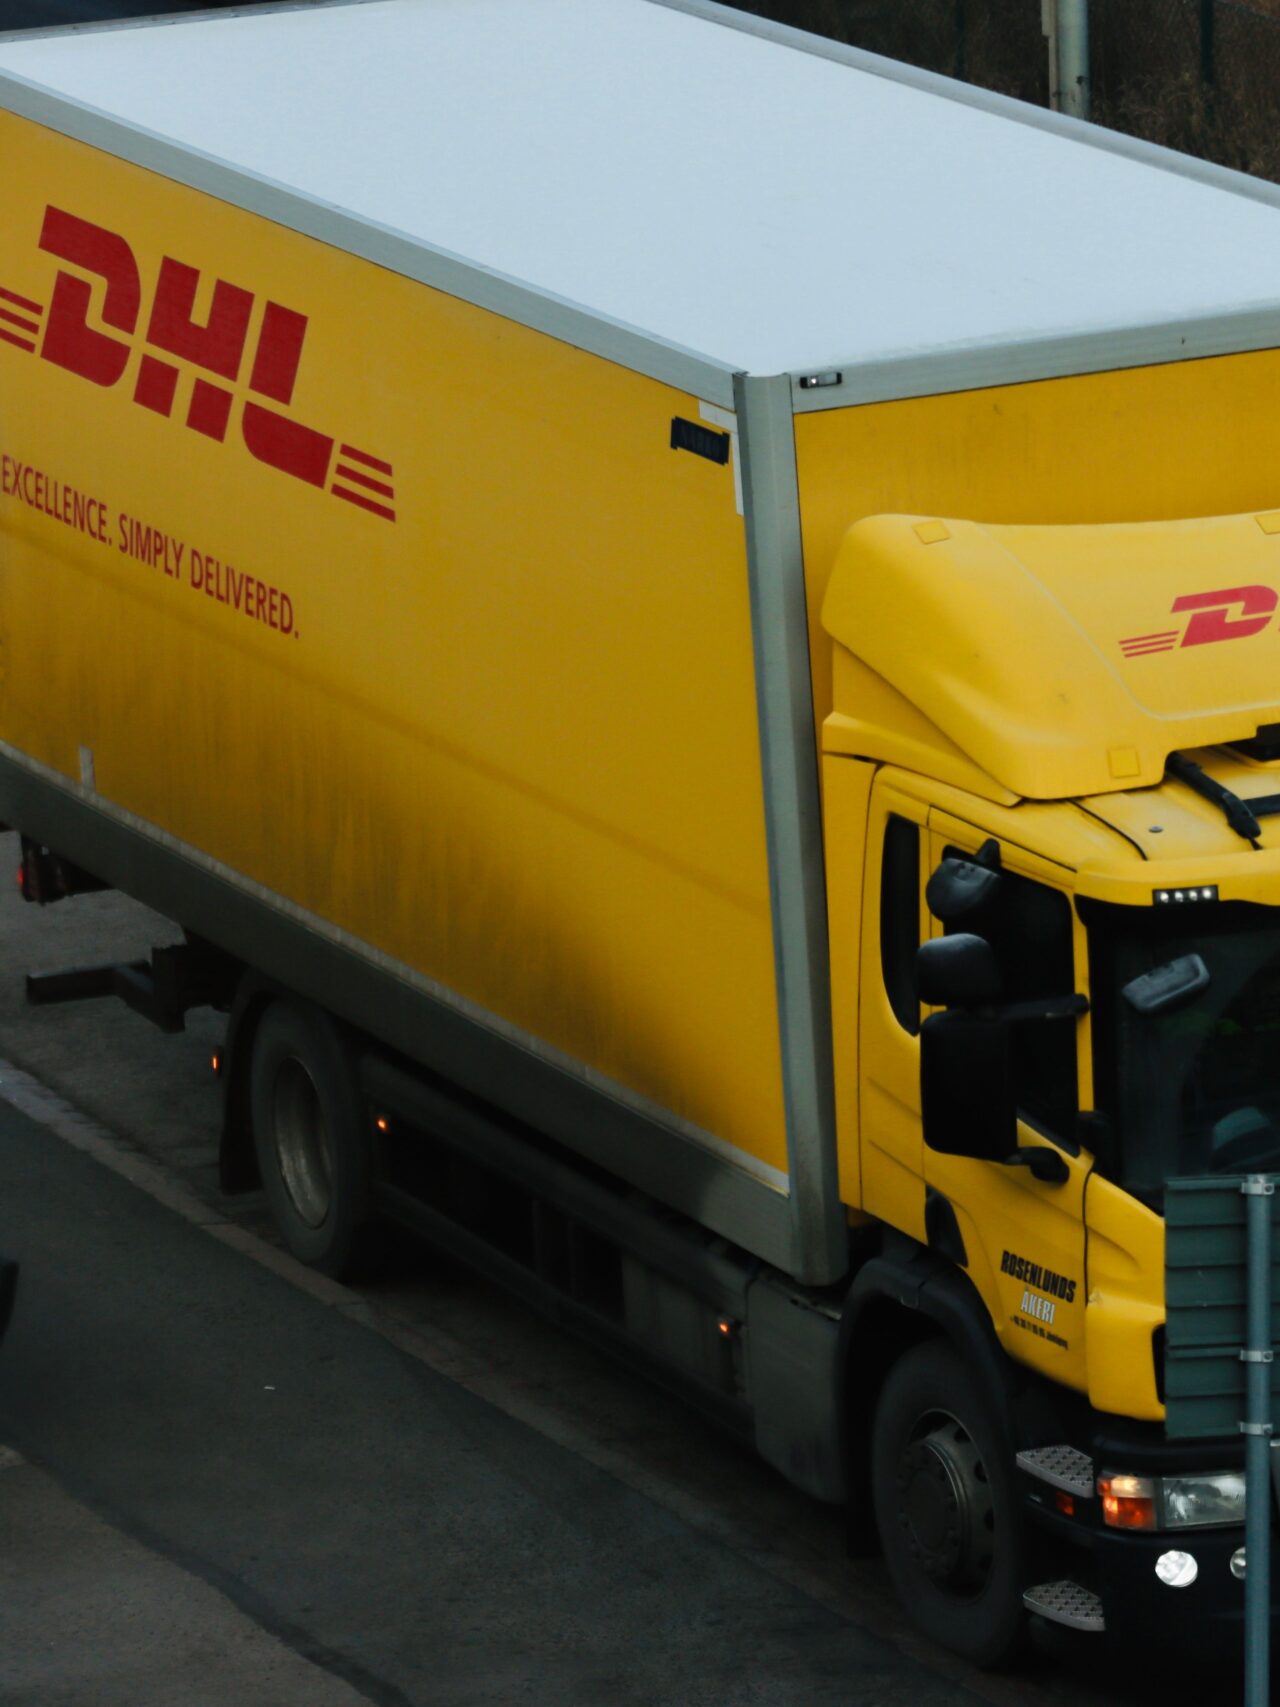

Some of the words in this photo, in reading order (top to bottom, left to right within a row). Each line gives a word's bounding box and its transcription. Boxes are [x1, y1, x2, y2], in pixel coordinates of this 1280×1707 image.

[39, 204, 335, 490] DHL
[2, 454, 112, 547] EXCELLENCE.
[118, 512, 185, 580] SIMPLY
[190, 547, 300, 640] DELIVERED.
[1000, 1249, 1077, 1304] ROSENLUNDS
